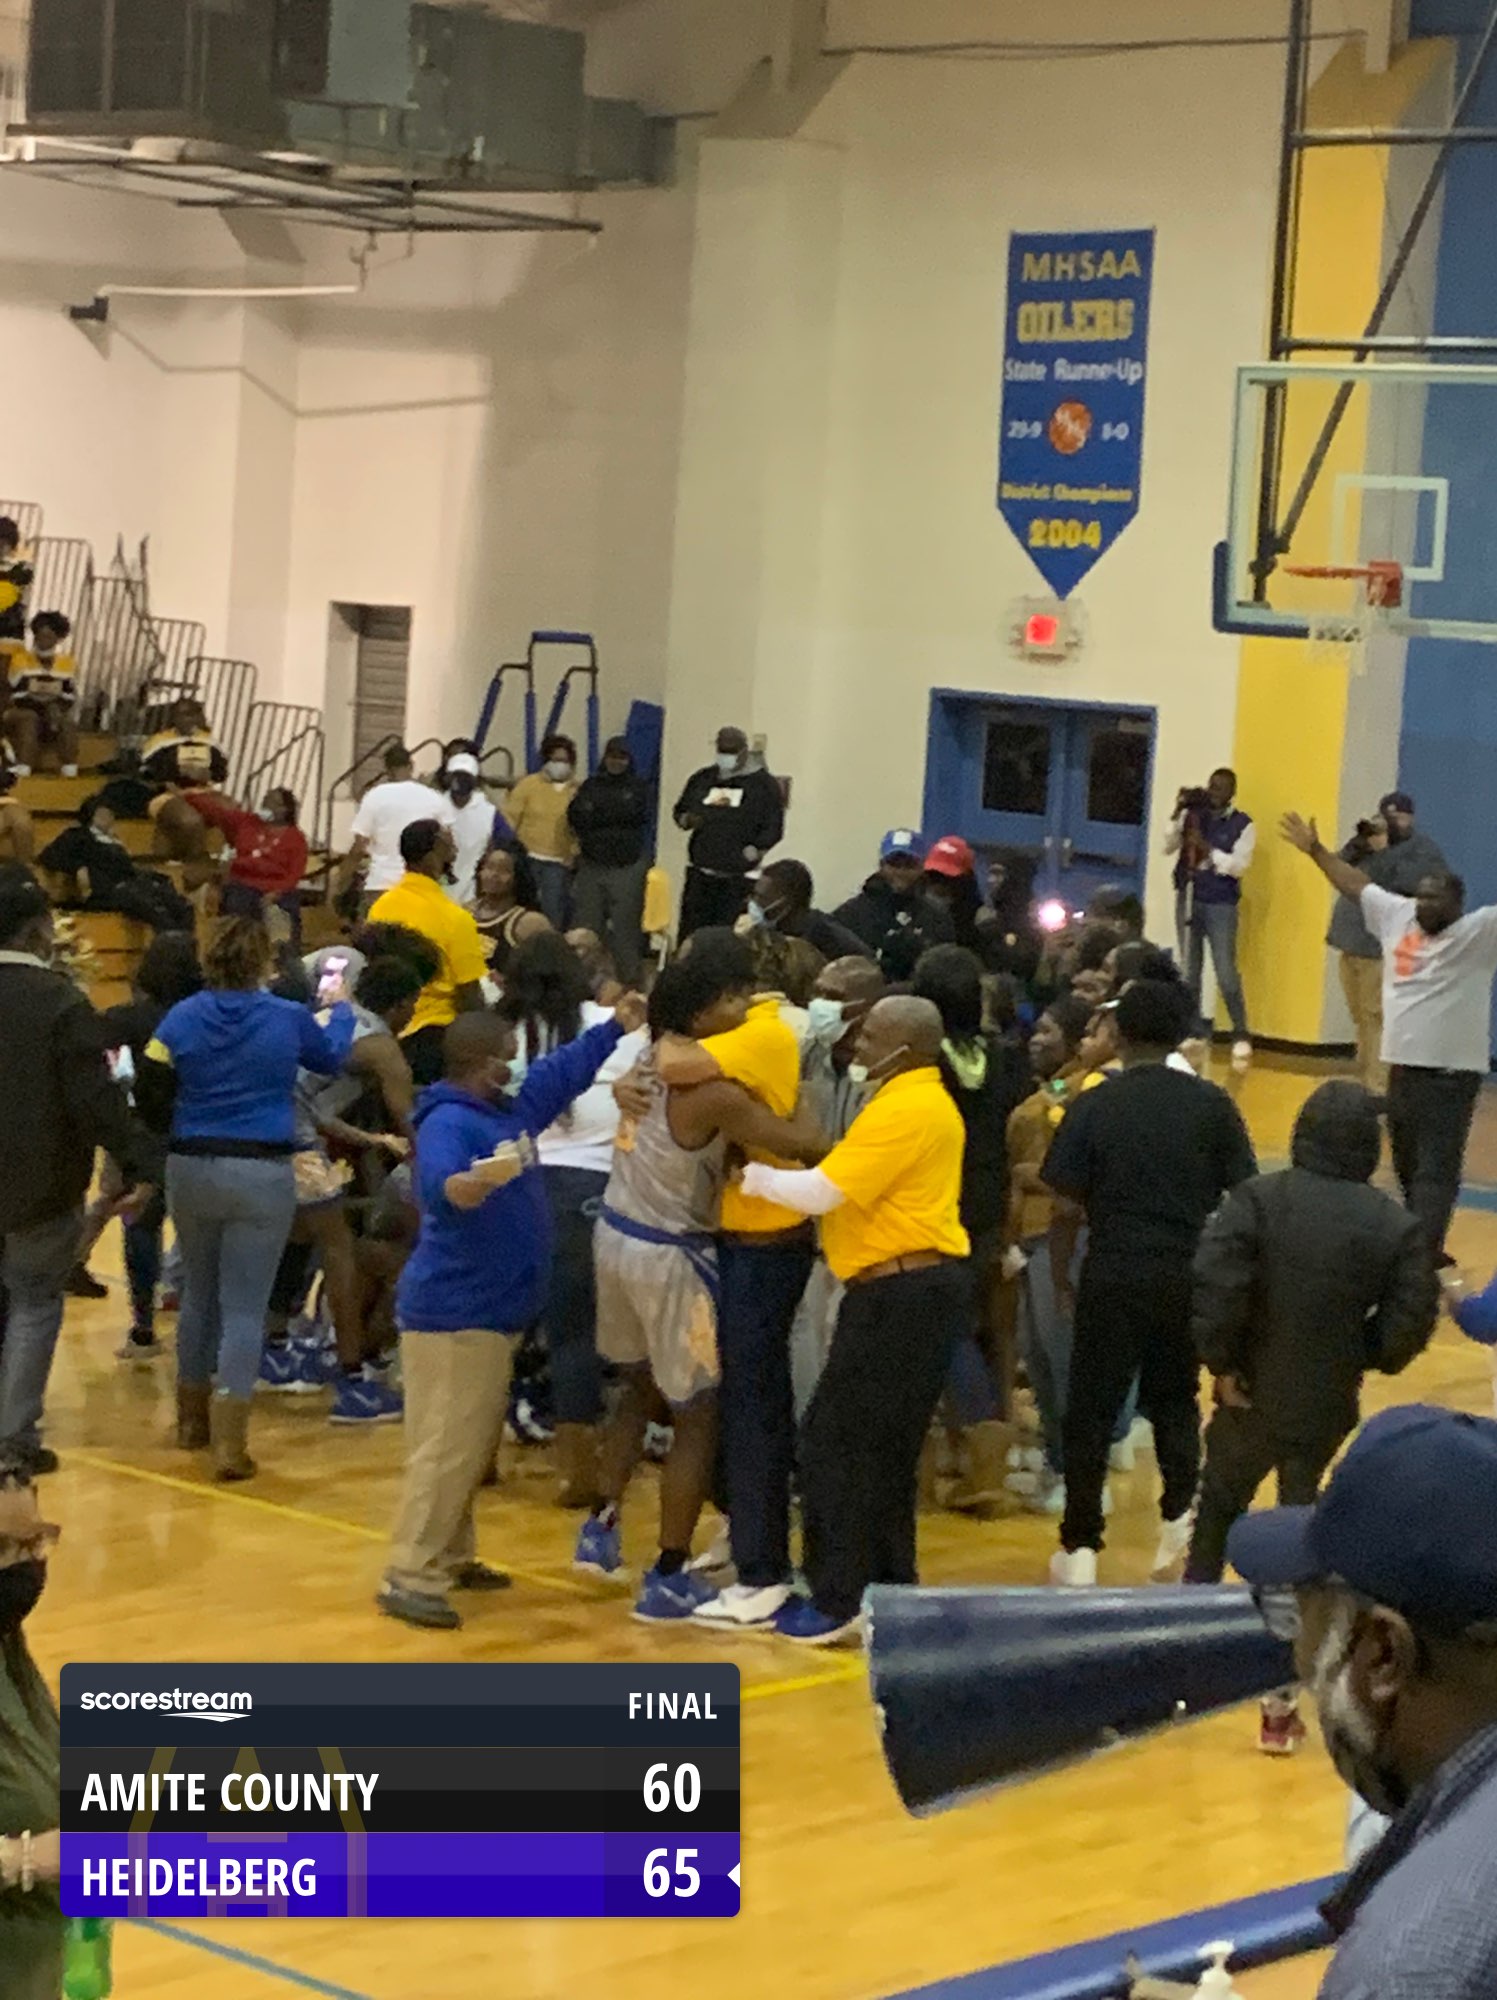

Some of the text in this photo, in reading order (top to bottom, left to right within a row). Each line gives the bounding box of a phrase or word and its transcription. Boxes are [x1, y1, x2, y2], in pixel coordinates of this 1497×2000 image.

[1022, 250, 1140, 281] MHSAA
[1018, 299, 1133, 342] OILERS
[1004, 358, 1047, 381] State
[1028, 519, 1101, 549] 2004
